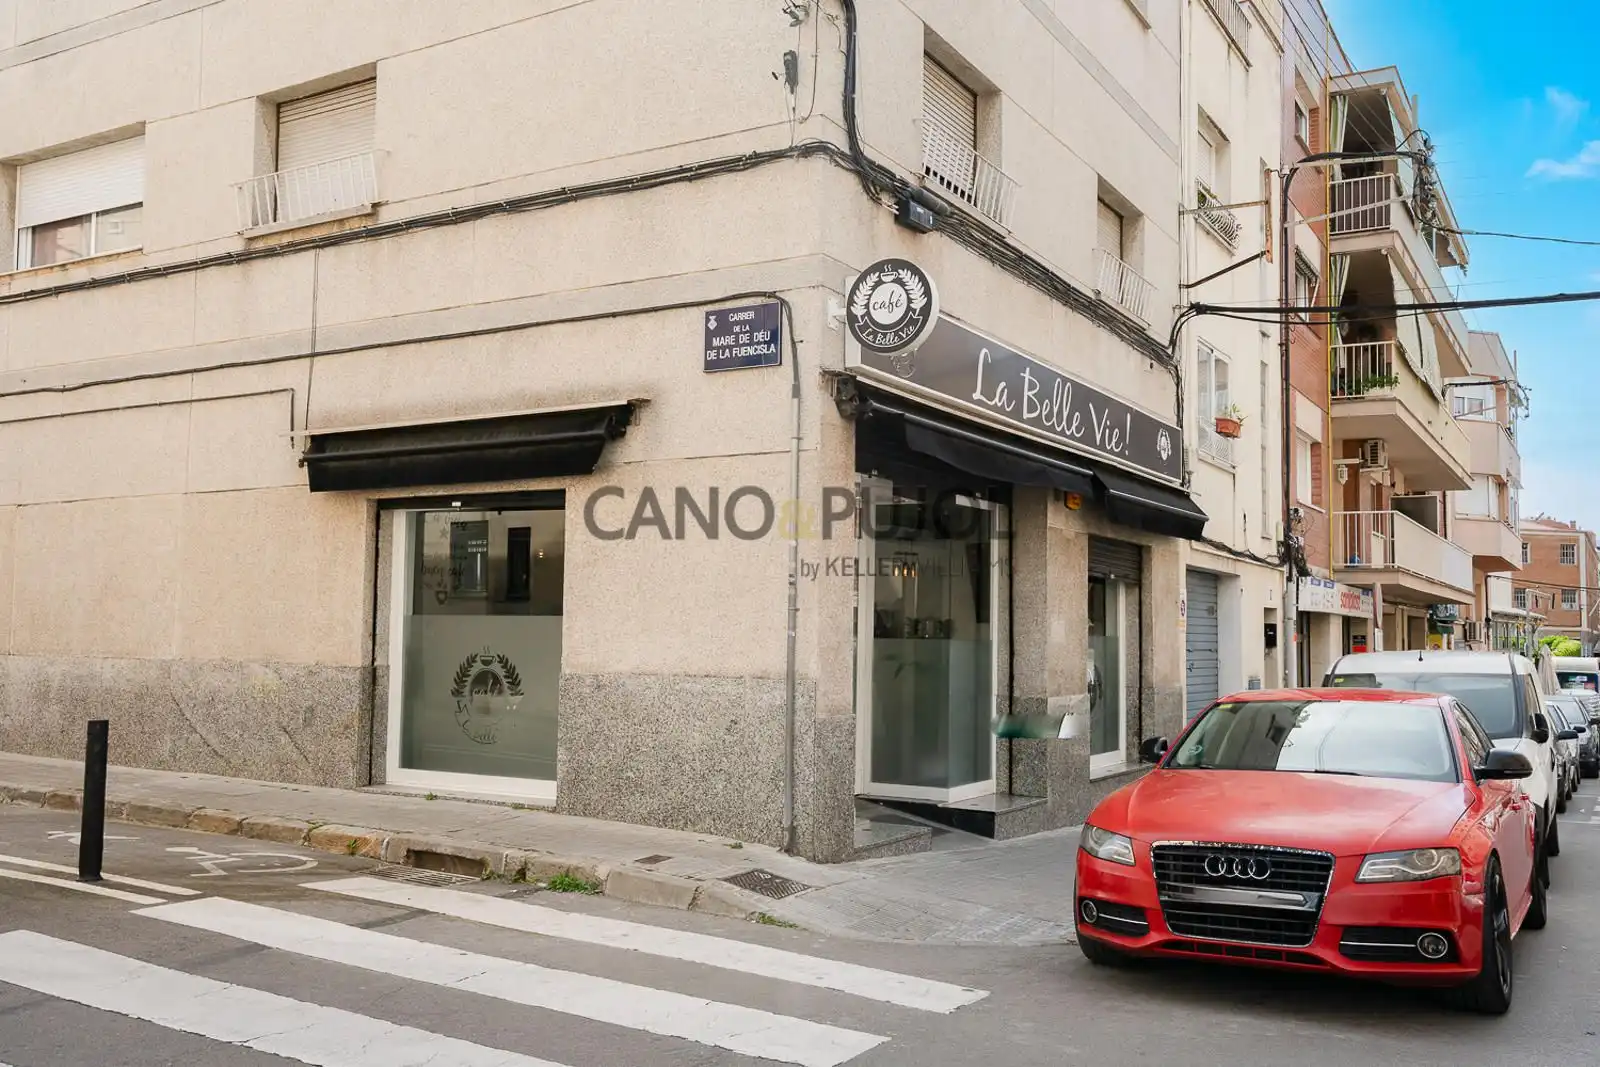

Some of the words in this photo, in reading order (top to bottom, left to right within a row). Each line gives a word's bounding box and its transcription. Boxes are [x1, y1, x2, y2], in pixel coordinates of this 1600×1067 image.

[872, 289, 902, 314] café
[728, 311, 755, 322] CARRER
[733, 325, 741, 333] DE
[742, 324, 750, 332] LA
[863, 328, 875, 342] La
[875, 332, 900, 345] Belle
[899, 325, 915, 338] Vie
[712, 335, 736, 347] MARE
[739, 333, 751, 344] DE
[753, 329, 771, 342] DÉU
[706, 350, 718, 361] DE
[719, 348, 731, 359] LA
[732, 343, 776, 358] FUENCISLA
[972, 347, 1016, 412] La
[1020, 367, 1085, 437] Belle
[1088, 402, 1132, 456] Vie!
